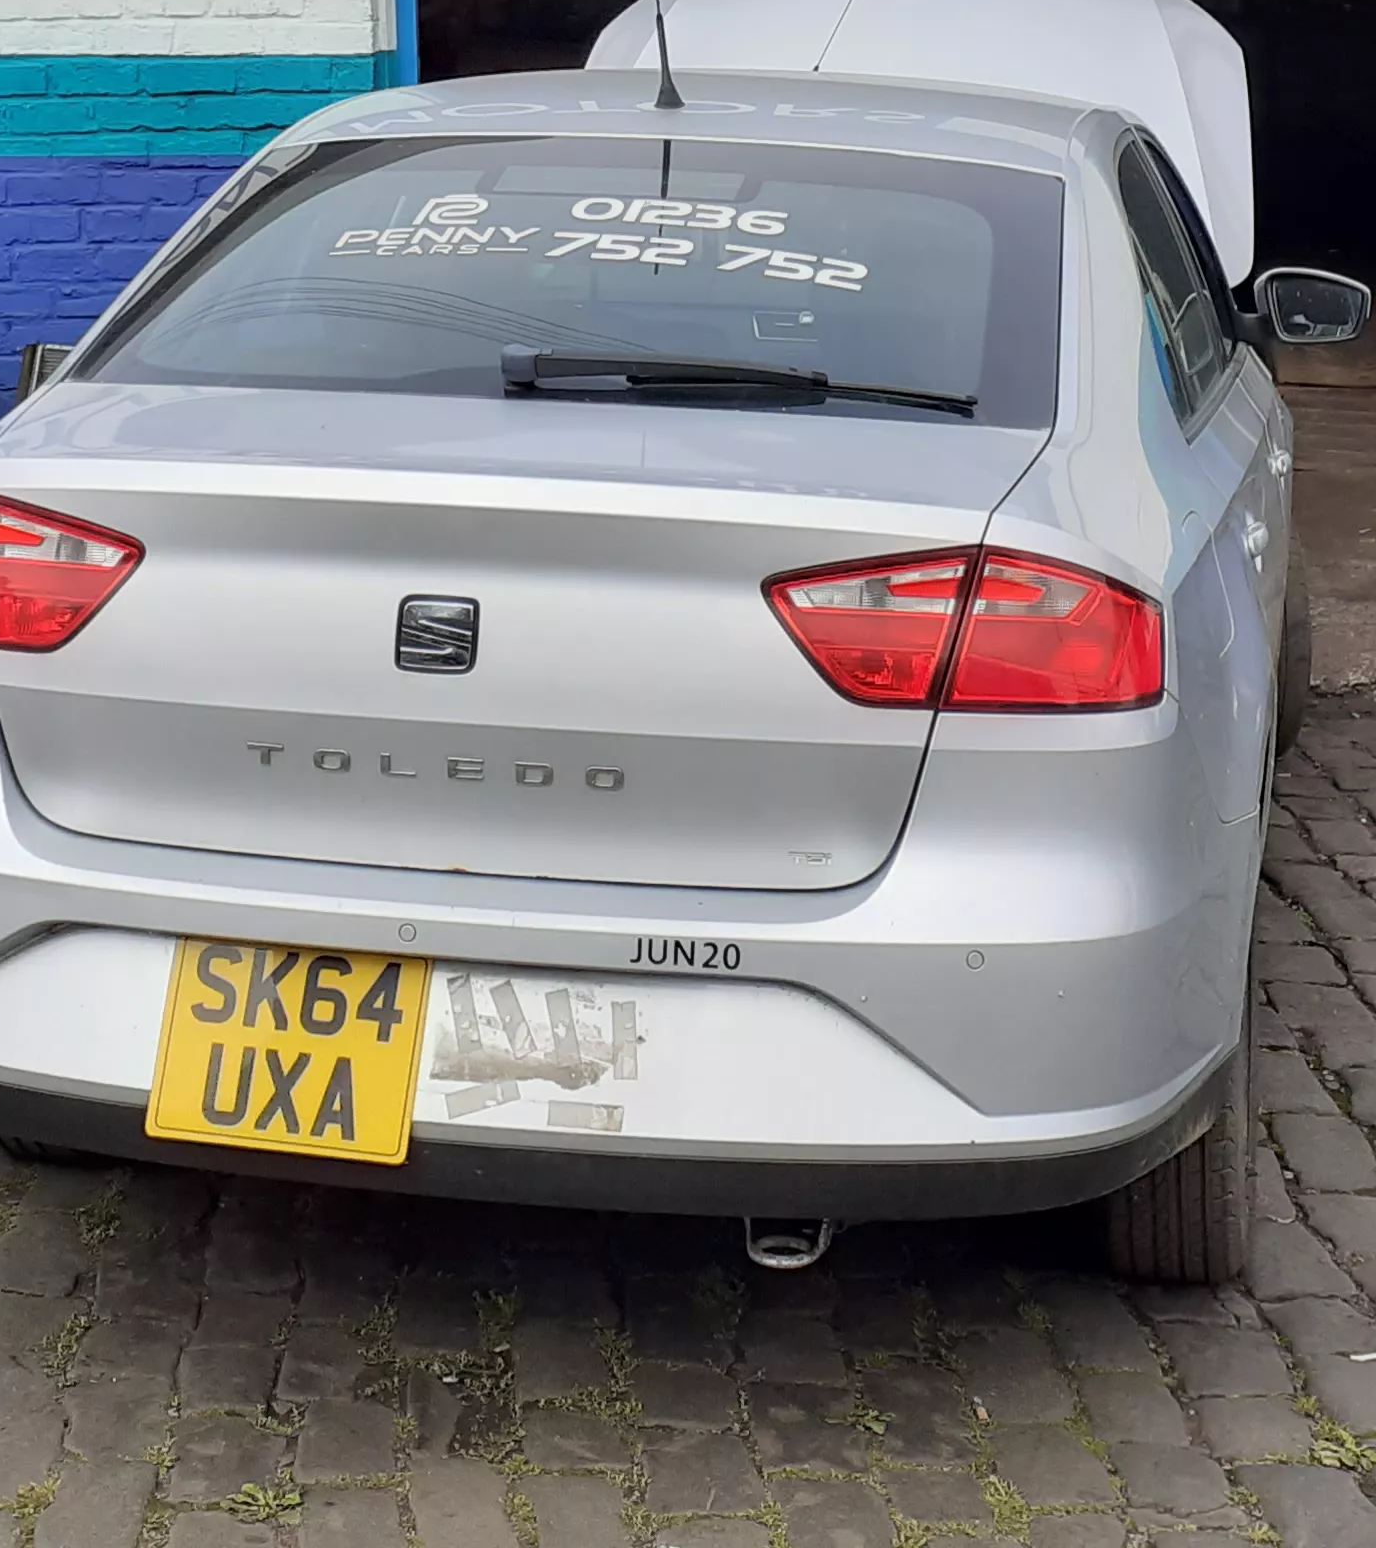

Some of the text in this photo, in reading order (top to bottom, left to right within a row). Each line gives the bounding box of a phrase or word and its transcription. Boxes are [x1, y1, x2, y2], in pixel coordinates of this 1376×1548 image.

[335, 226, 541, 248] PENNY
[572, 197, 788, 235] 01236
[376, 244, 481, 256] CARS
[544, 232, 868, 291] 752 752
[246, 741, 625, 791] TOLEDO
[190, 944, 403, 1042] SK64
[201, 1043, 356, 1141] UXA
